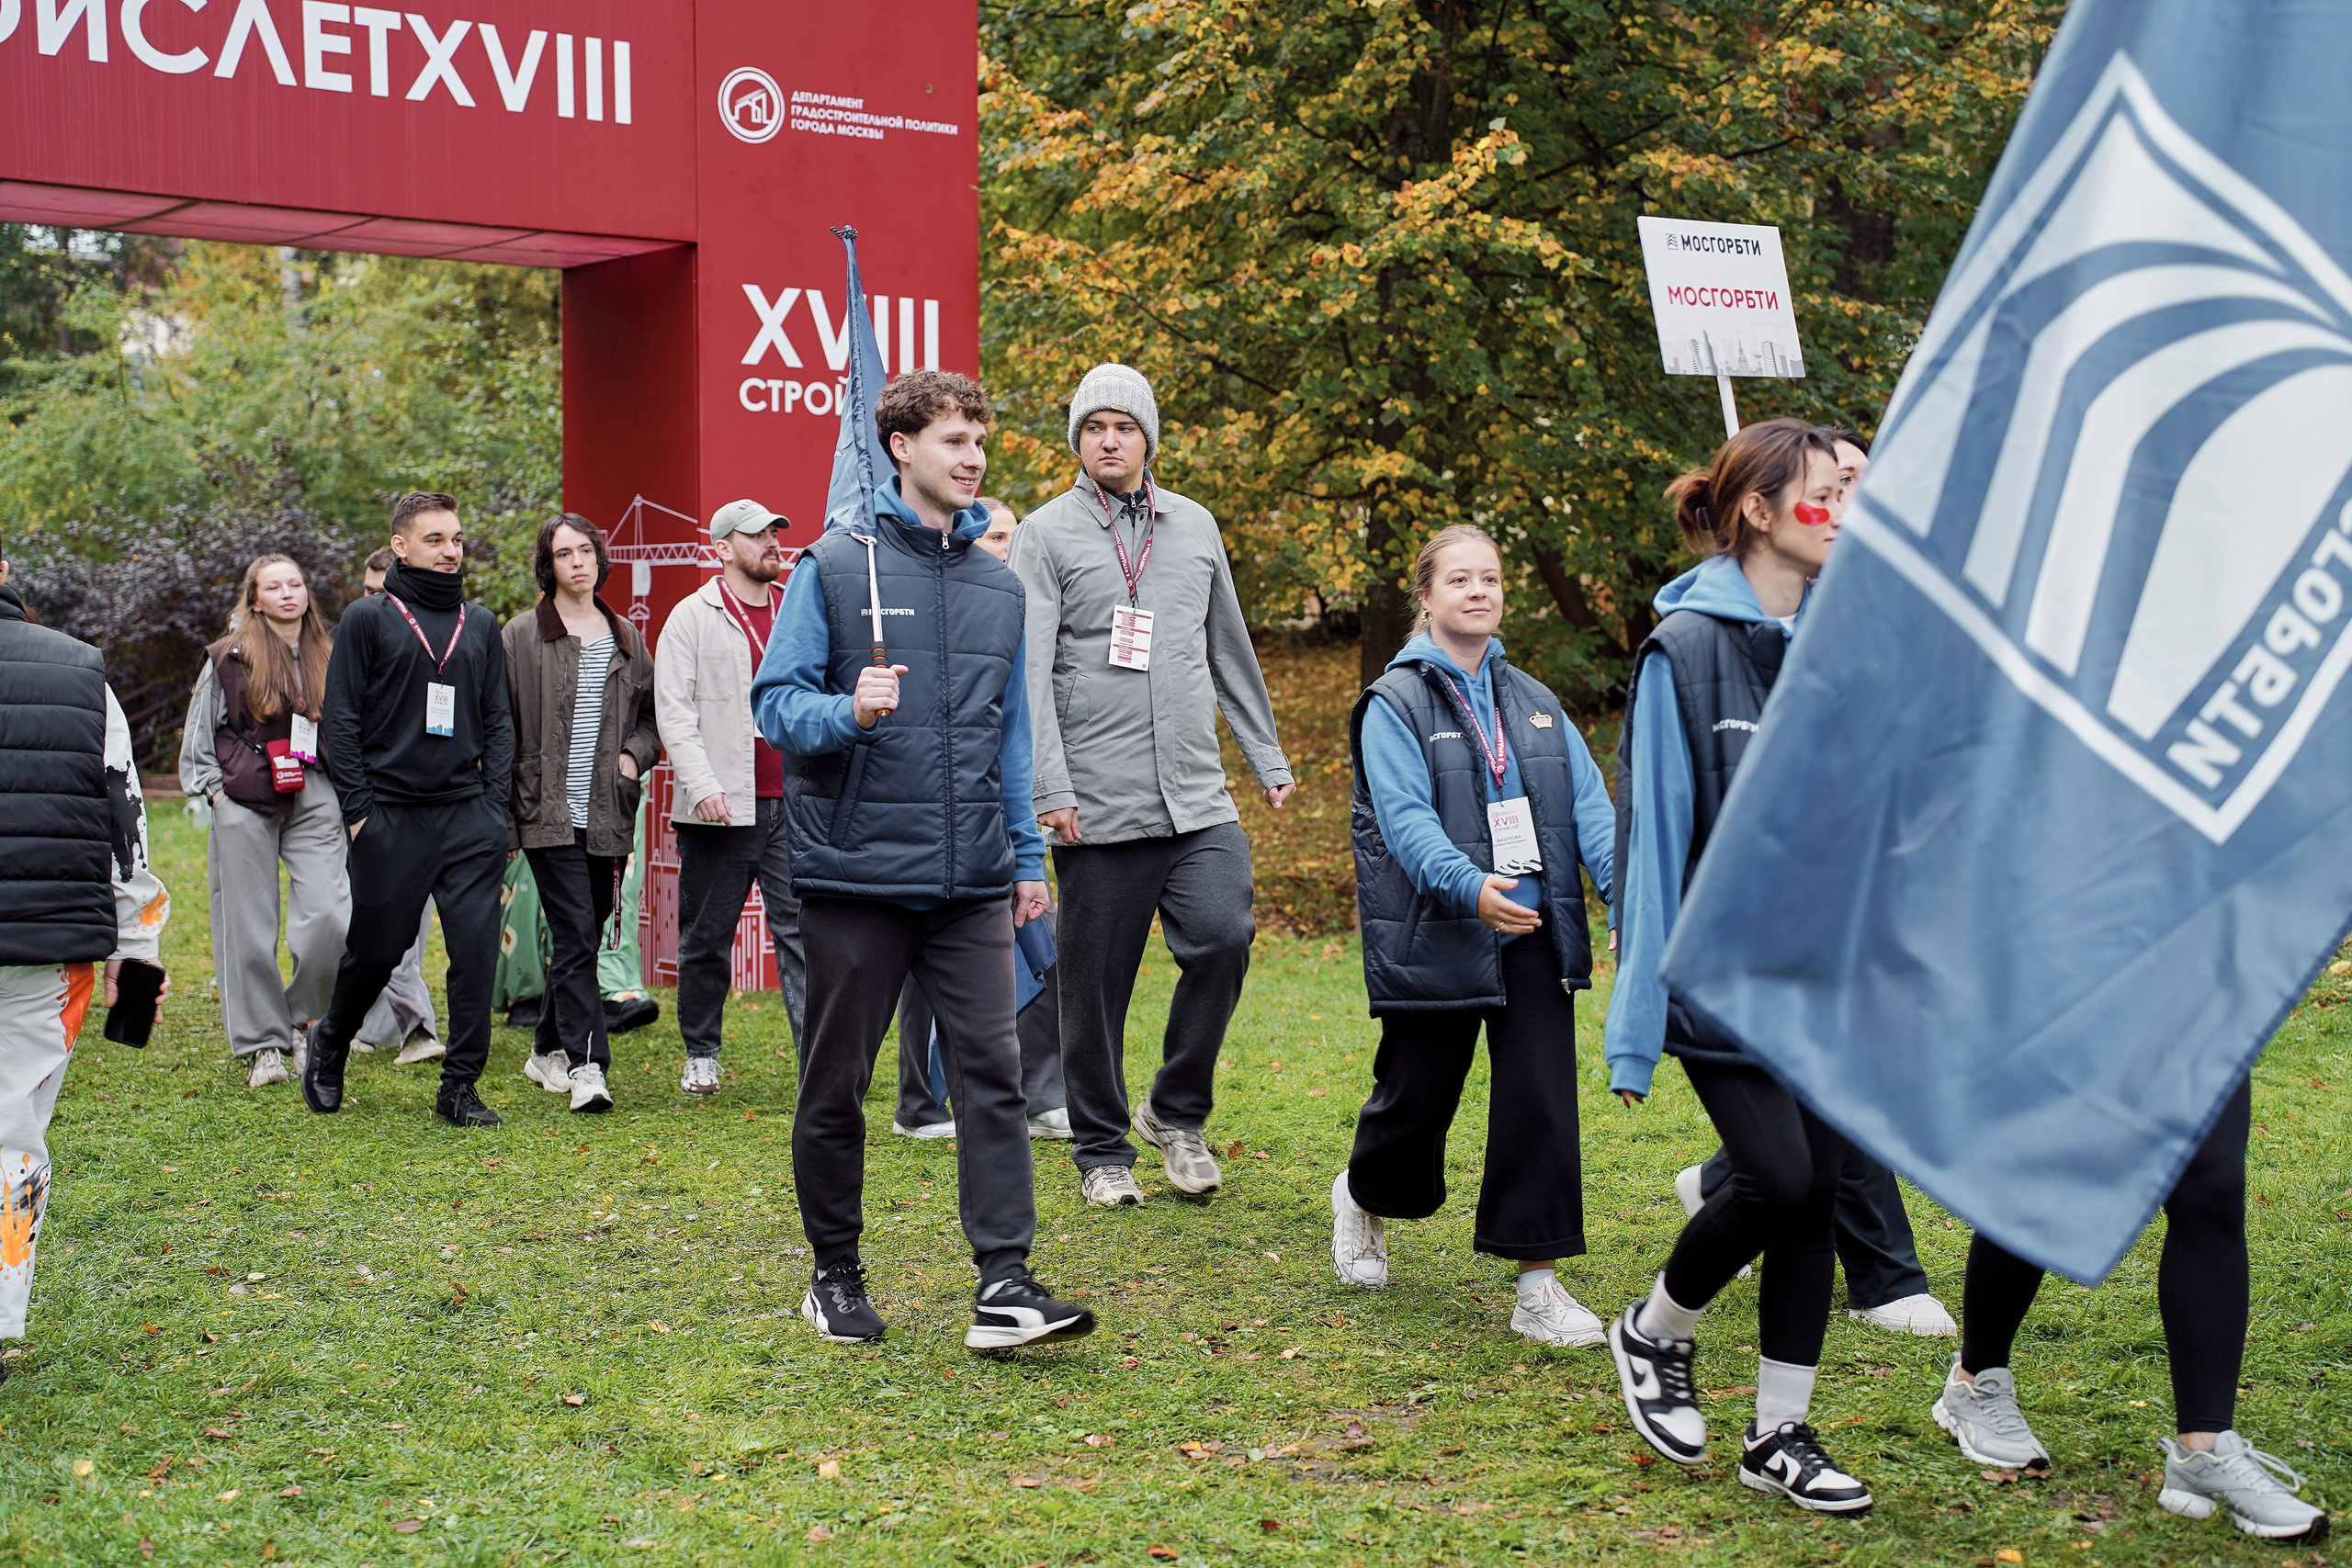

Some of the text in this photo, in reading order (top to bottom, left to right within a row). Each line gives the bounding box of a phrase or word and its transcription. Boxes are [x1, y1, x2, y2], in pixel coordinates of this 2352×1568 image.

[790, 91, 865, 109] ДЕПАРТАМЕНТ
[790, 105, 959, 136] ГРАДОСТРОИТЕЛЬНОЙ ПОЛИТИКИ
[790, 118, 885, 140] ГОРОДА МОСКВЫ
[1680, 234, 1761, 256] МОСГОРБТИ
[1668, 285, 1779, 310] МОСГОРБТИ
[741, 283, 940, 375] XVIII
[869, 608, 915, 616] СГОРБТИ
[1493, 815, 1519, 828] XVIII
